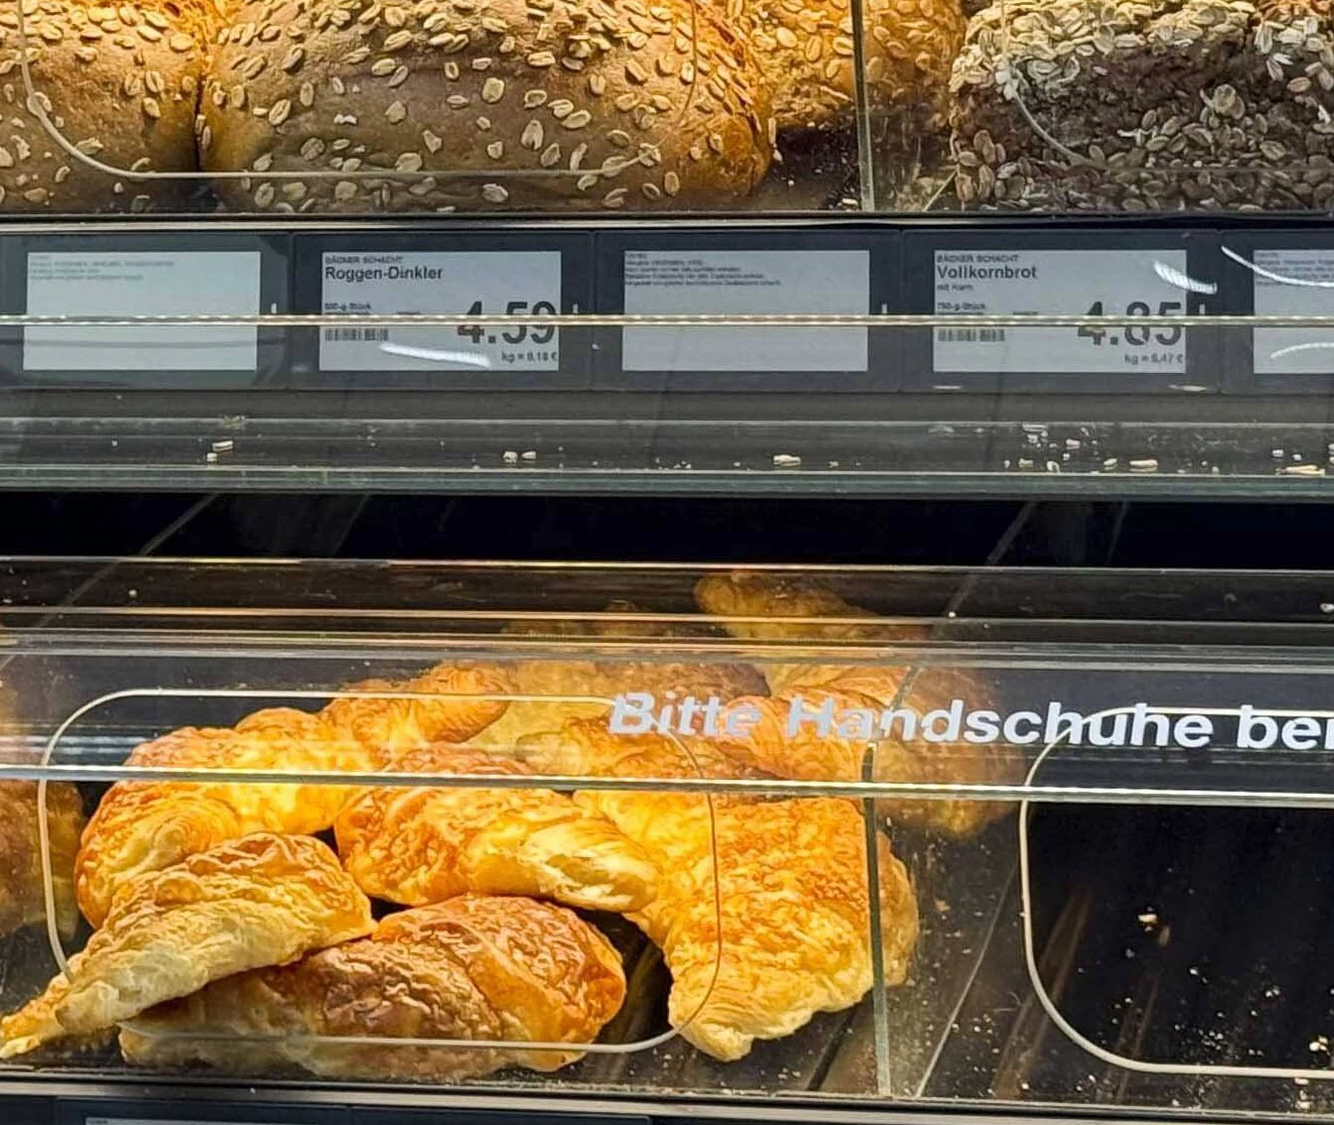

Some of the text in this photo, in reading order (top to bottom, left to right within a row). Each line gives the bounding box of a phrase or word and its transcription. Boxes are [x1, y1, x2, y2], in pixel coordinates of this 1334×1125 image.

[325, 266, 443, 282] Roggen-Dinkler
[937, 265, 1037, 279] Vollkornbrot
[457, 301, 557, 344] 4.59
[501, 352, 515, 364] kg
[1124, 354, 1139, 365] kg
[609, 690, 759, 738] Bitte
[786, 697, 1213, 748] Handschuhe
